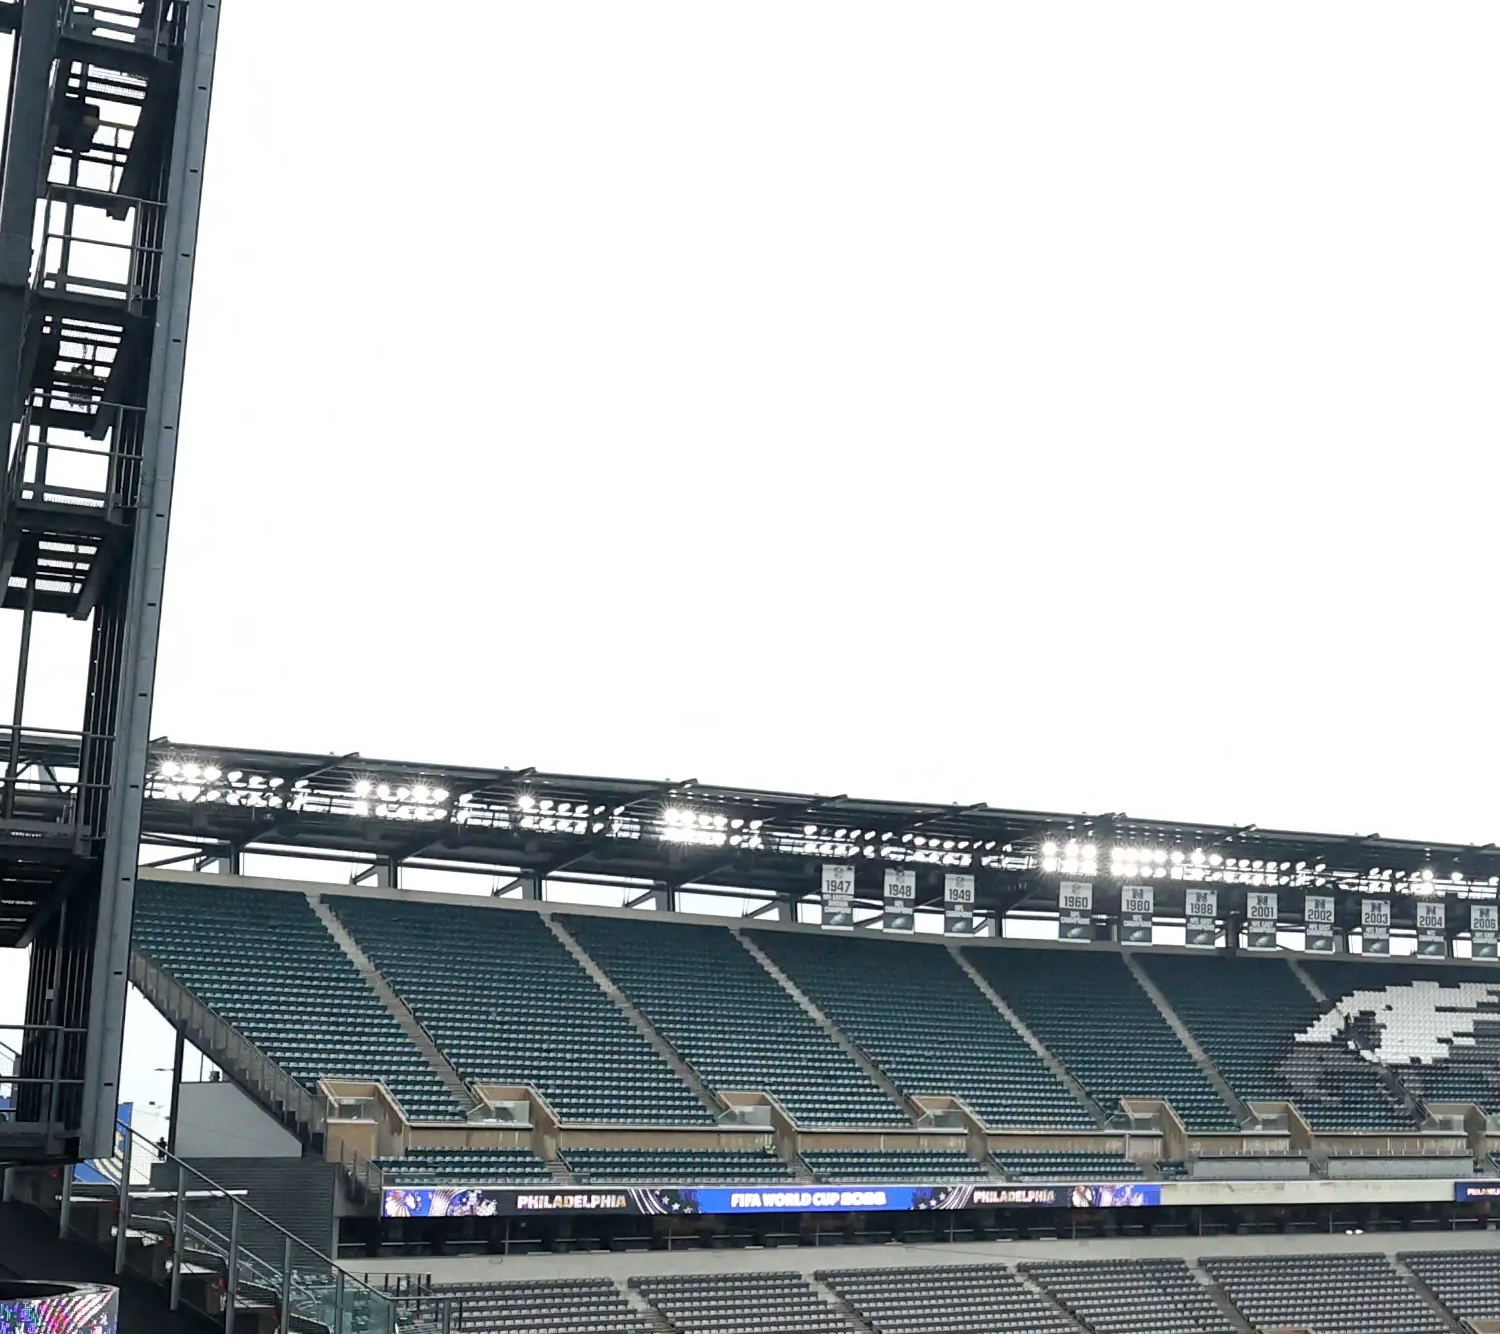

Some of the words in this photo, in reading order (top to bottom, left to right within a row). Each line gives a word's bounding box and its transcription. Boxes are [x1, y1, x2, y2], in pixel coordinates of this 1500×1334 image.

[826, 880, 851, 893] 1947
[888, 883, 912, 897] 1948
[949, 888, 971, 902] 1949
[1064, 896, 1088, 908] 1960
[1126, 899, 1150, 912] 1980
[1190, 902, 1213, 915] 1988
[1251, 906, 1274, 918] 2001
[1308, 909, 1332, 921] 2002
[1364, 913, 1388, 925] 2003
[1419, 916, 1443, 927] 2004
[1473, 918, 1496, 929] 2006
[517, 1195, 627, 1209] PHILADELPHIA
[731, 1193, 761, 1208] FIFA
[762, 1192, 812, 1207] WORLD
[973, 1190, 1055, 1204] PHILADELPHIA
